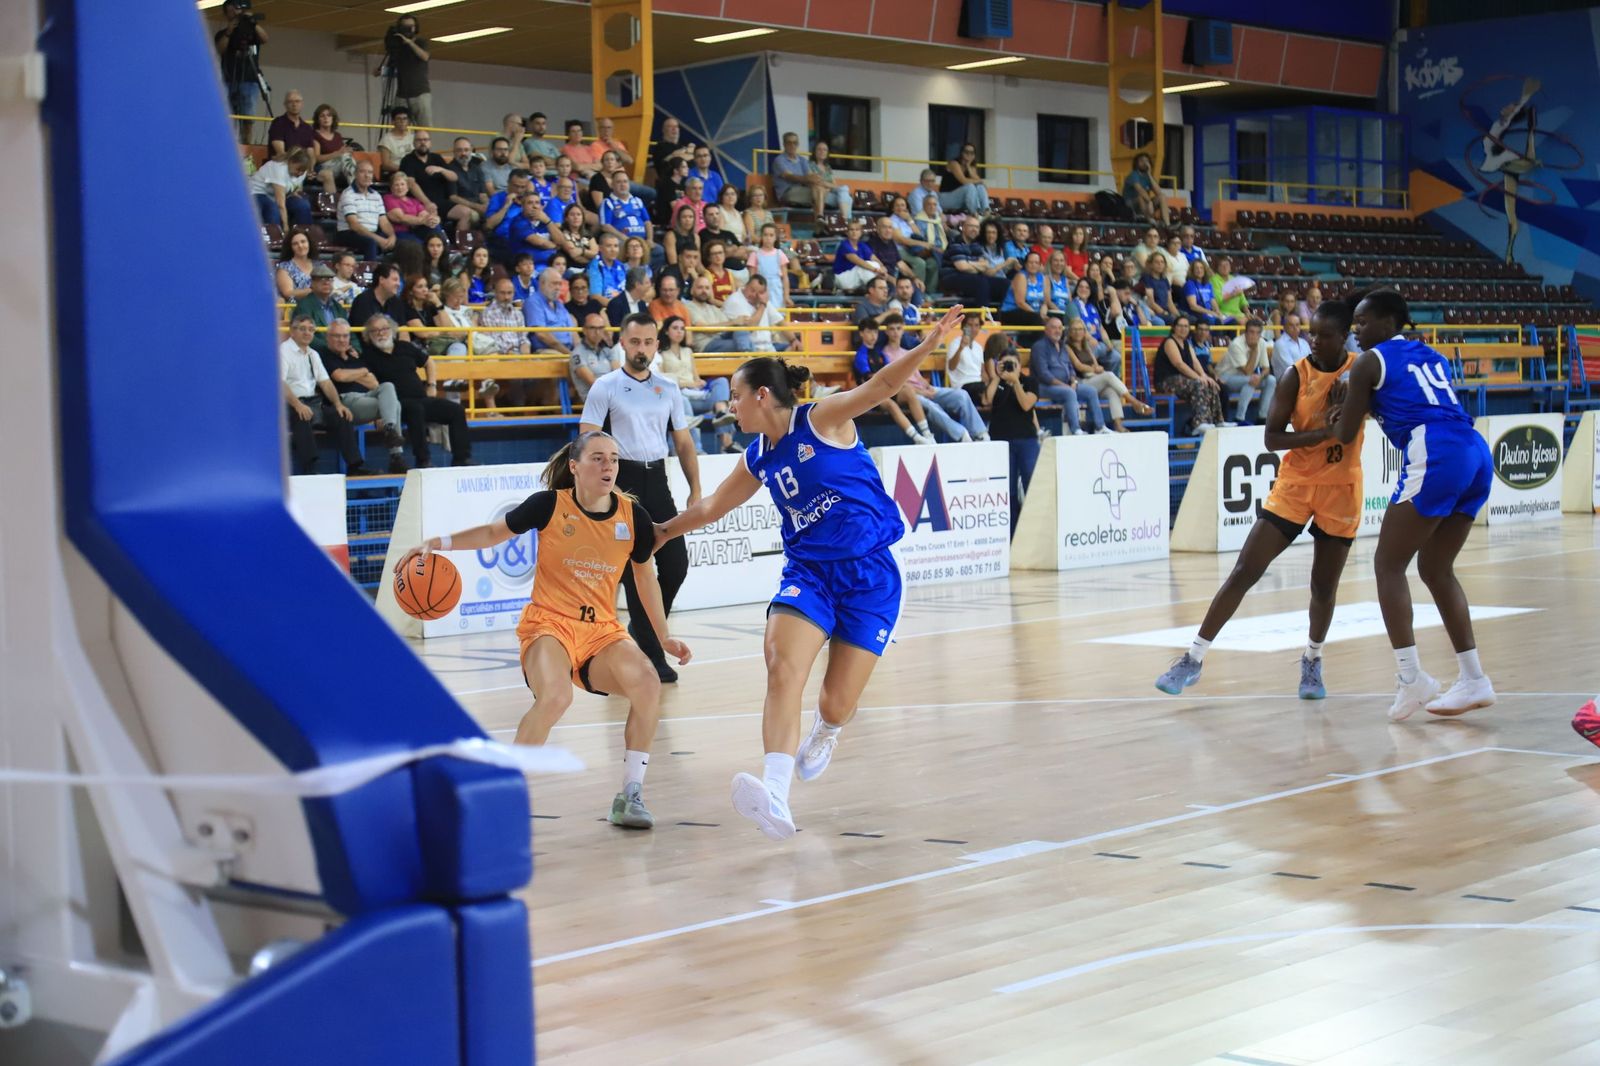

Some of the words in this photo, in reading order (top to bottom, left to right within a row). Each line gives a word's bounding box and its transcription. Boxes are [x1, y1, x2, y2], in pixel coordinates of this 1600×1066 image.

[1408, 361, 1458, 406] 14
[1327, 444, 1343, 463] 23
[1499, 441, 1529, 472] Paulino
[1531, 440, 1557, 470] Iglesias
[775, 466, 799, 499] 13
[1490, 500, 1560, 517] www.paulinoiglesias.com
[1065, 523, 1128, 547] recoletas
[1131, 518, 1161, 541] salud
[1224, 516, 1253, 526] GIMNASIO
[906, 570, 920, 581] 980
[945, 567, 954, 577] 90
